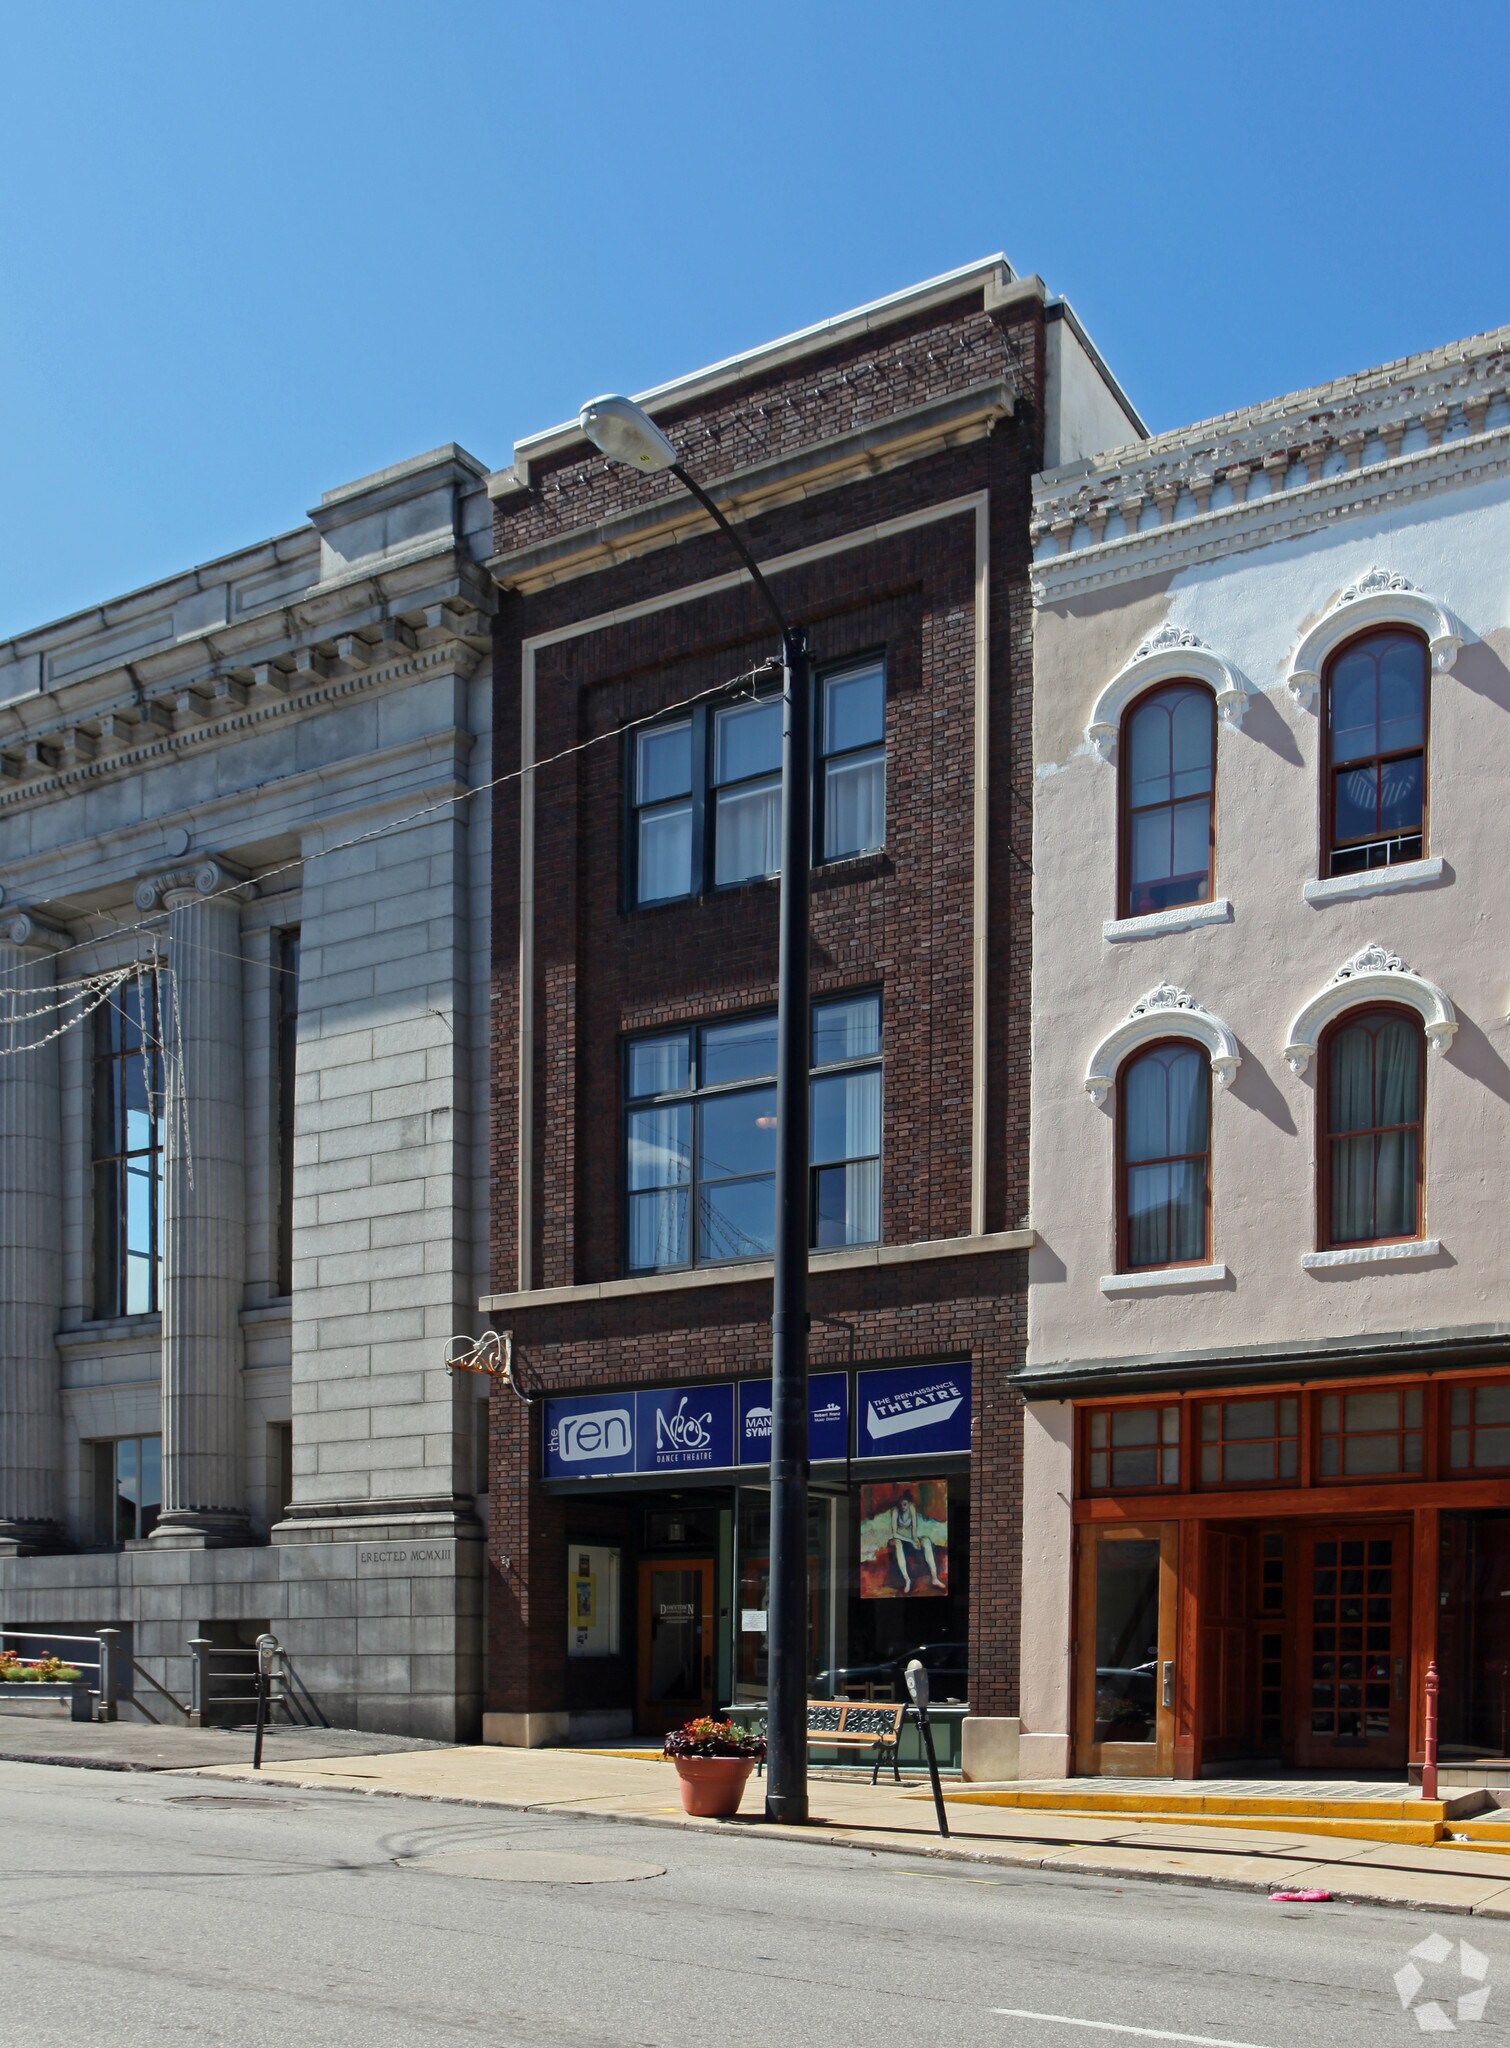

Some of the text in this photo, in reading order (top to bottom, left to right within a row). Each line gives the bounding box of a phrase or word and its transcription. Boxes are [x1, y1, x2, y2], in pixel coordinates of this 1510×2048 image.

[873, 1381, 955, 1406] THE RENAISSANCE
[877, 1387, 961, 1416] THEATRE
[548, 1428, 559, 1452] the
[564, 1417, 626, 1455] ren
[656, 1452, 712, 1463] DANCE THEATRE
[360, 1549, 451, 1563] ERECTED MCMXIII
